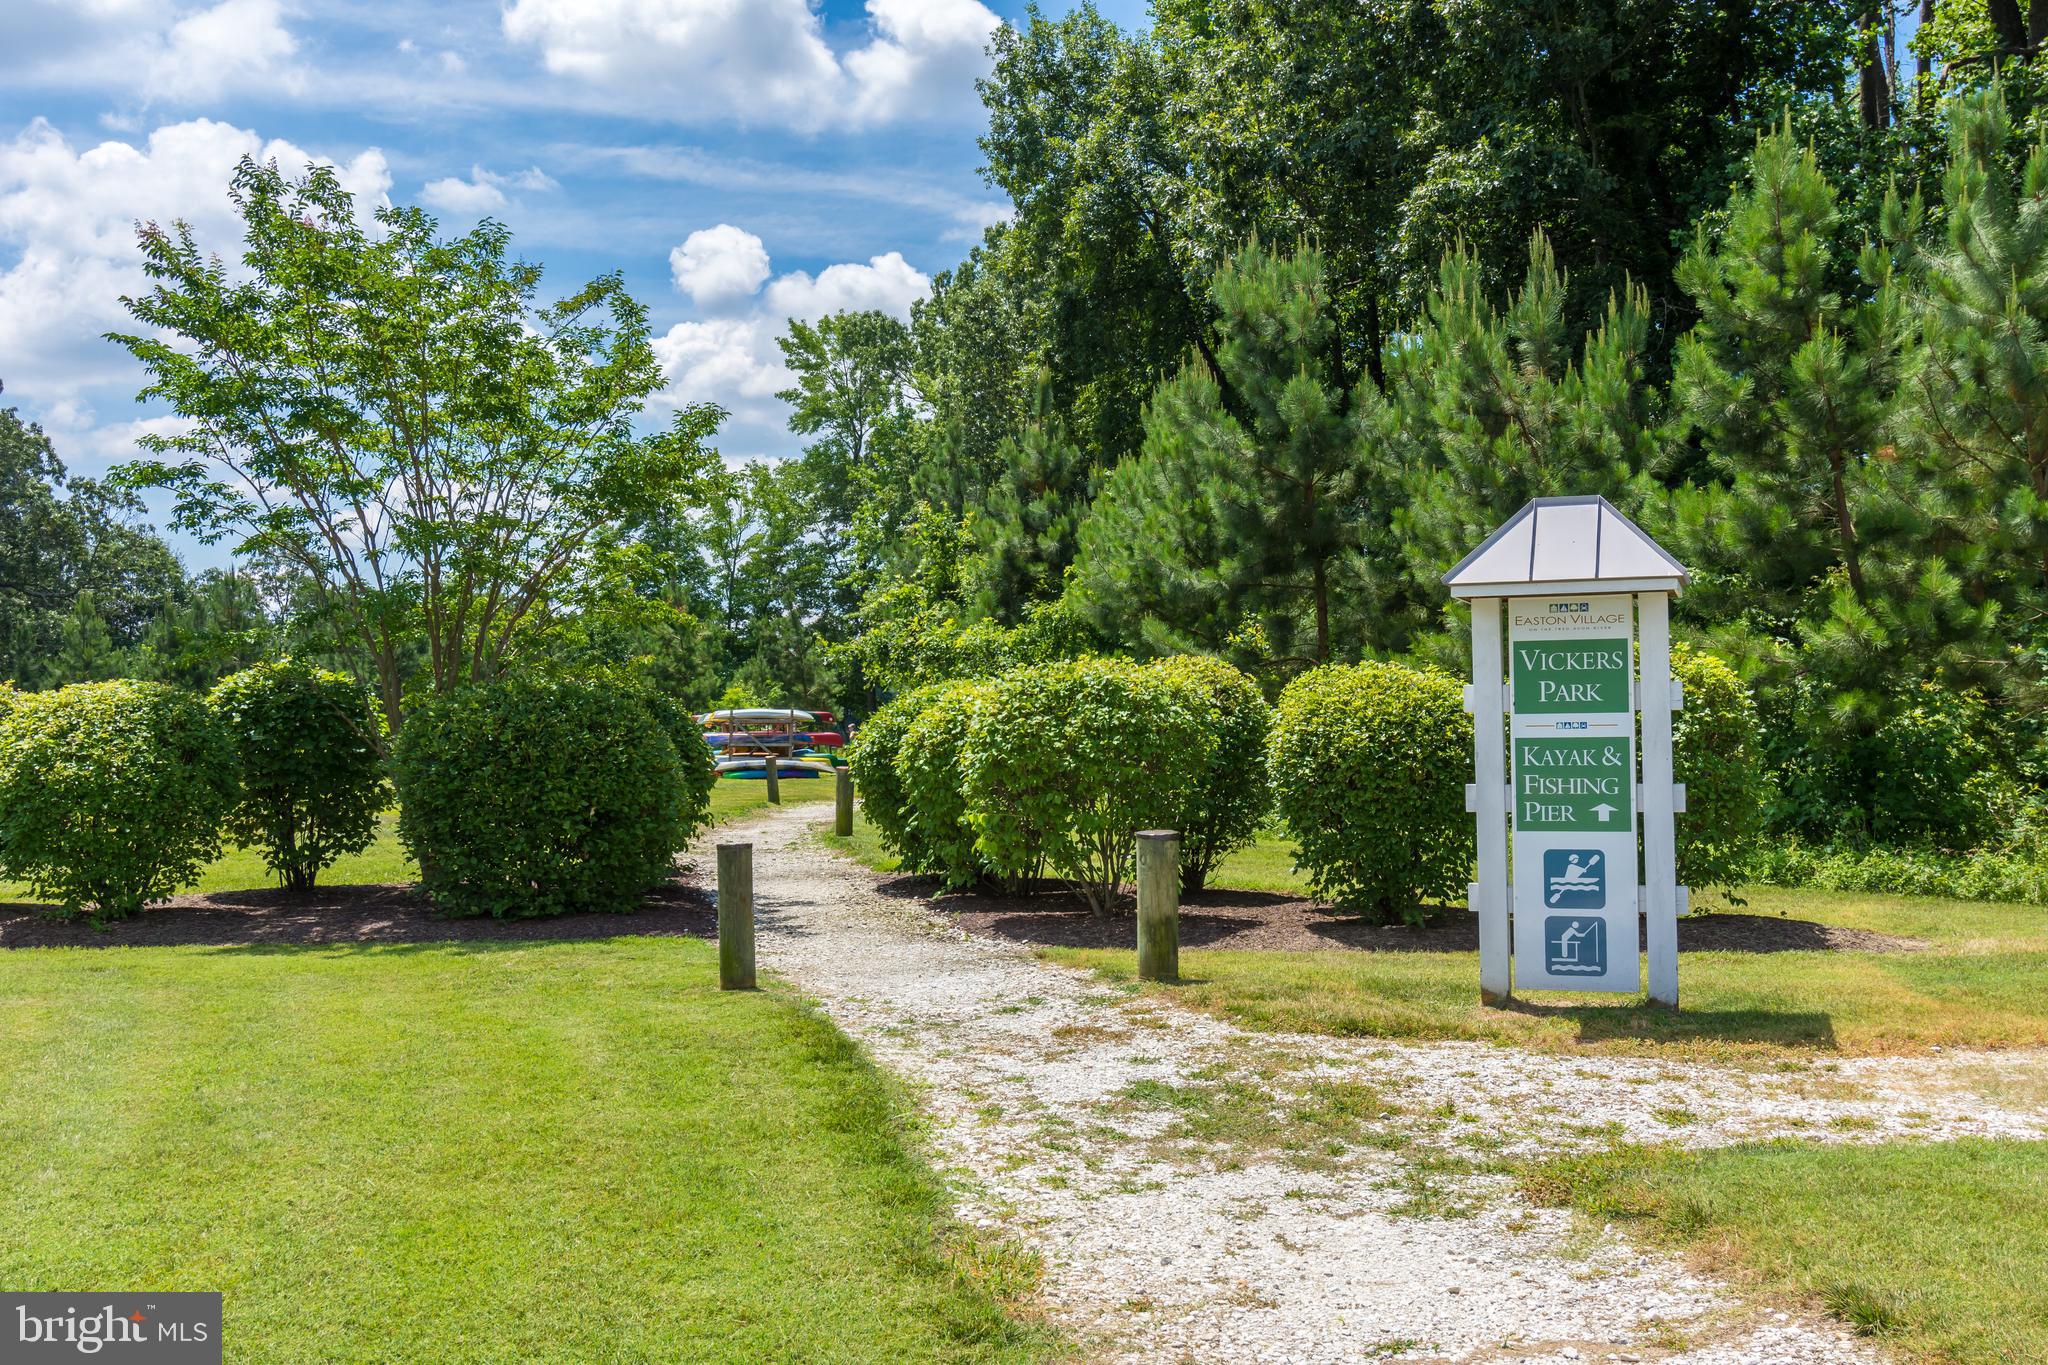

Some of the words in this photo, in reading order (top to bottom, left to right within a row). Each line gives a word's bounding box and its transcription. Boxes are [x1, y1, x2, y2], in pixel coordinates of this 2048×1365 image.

[1515, 615, 1567, 626] EASTON
[1570, 614, 1625, 624] VILLAGE
[1519, 649, 1623, 671] VICKERS
[1538, 680, 1605, 702] PARK
[1522, 746, 1598, 767] KAYAK
[1601, 745, 1622, 767] &
[1523, 774, 1619, 795] FISHING
[1523, 801, 1577, 822] PIER
